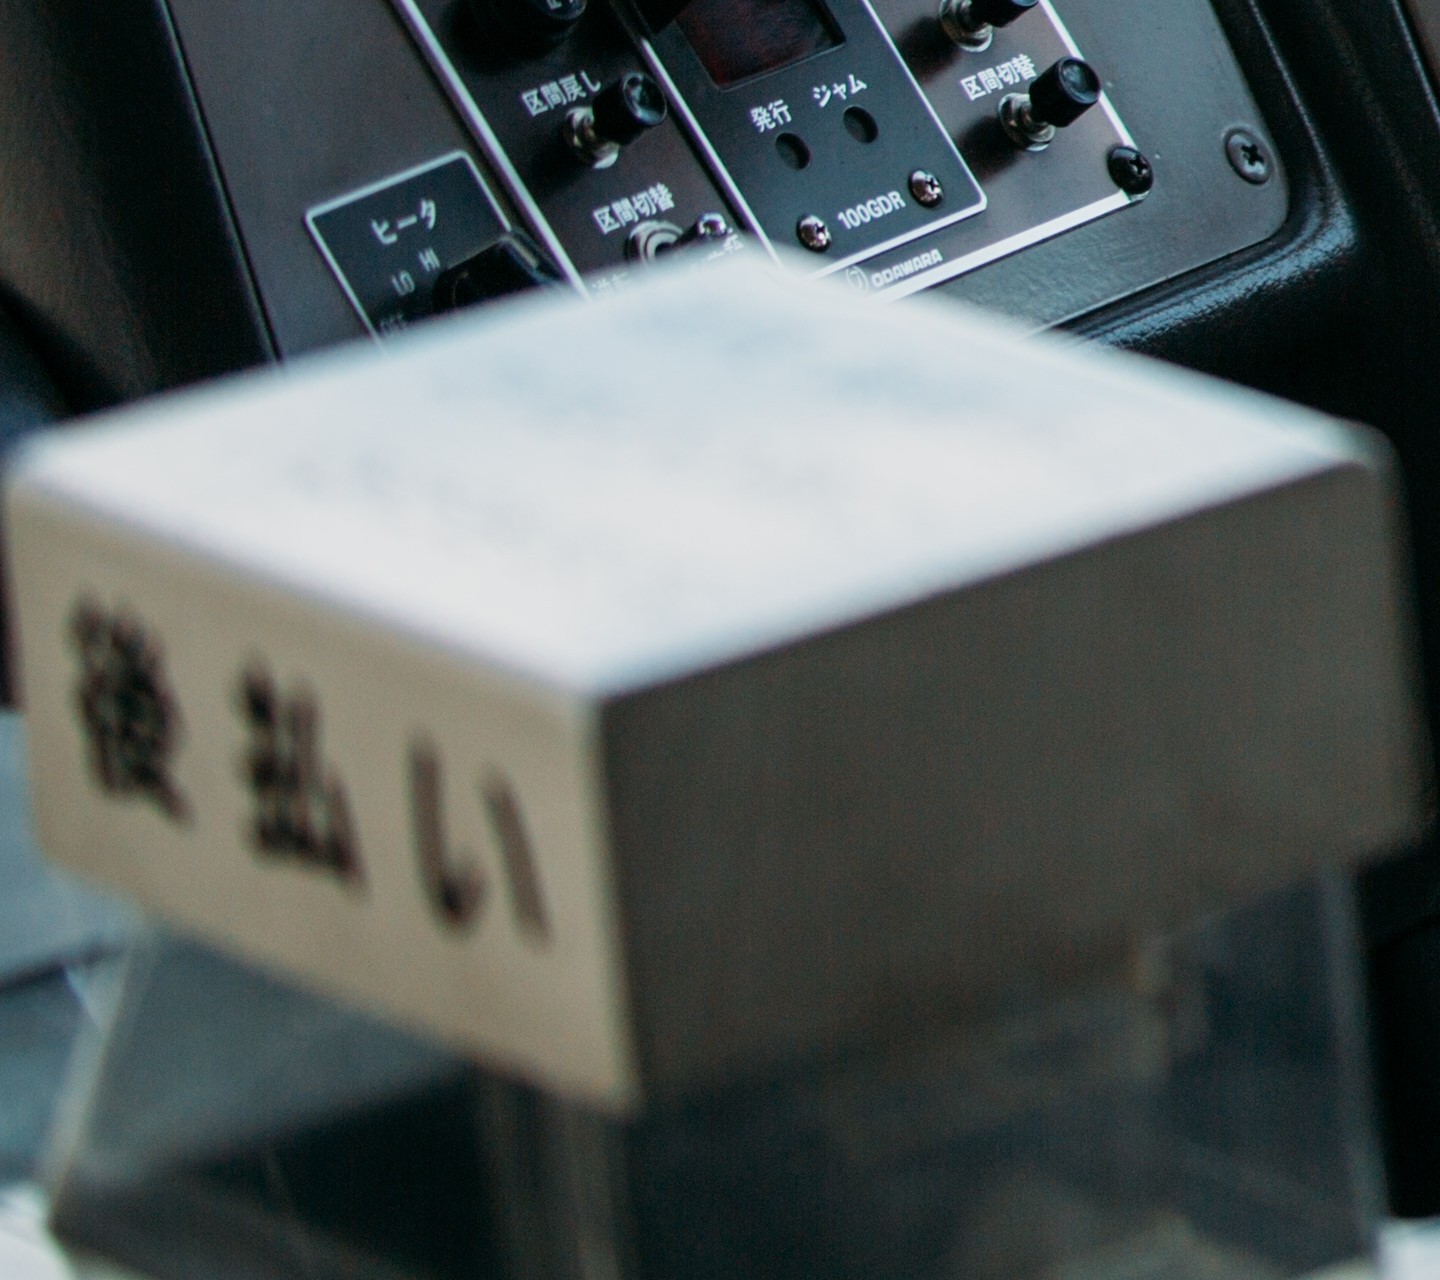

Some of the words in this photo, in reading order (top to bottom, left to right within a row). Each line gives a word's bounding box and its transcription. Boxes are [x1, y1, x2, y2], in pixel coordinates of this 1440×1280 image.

[520, 71, 602, 117] 区間戻し
[812, 73, 868, 108] ジャム
[960, 54, 1038, 102] 区間切替
[750, 99, 792, 133] 発行
[370, 198, 437, 246] ヒータ
[592, 182, 675, 234] 区間切替
[837, 190, 907, 230] 100GDR
[418, 247, 441, 273] HI
[870, 248, 944, 288] ODAWARA
[392, 270, 416, 297] LO
[66, 592, 554, 952] 後払い
